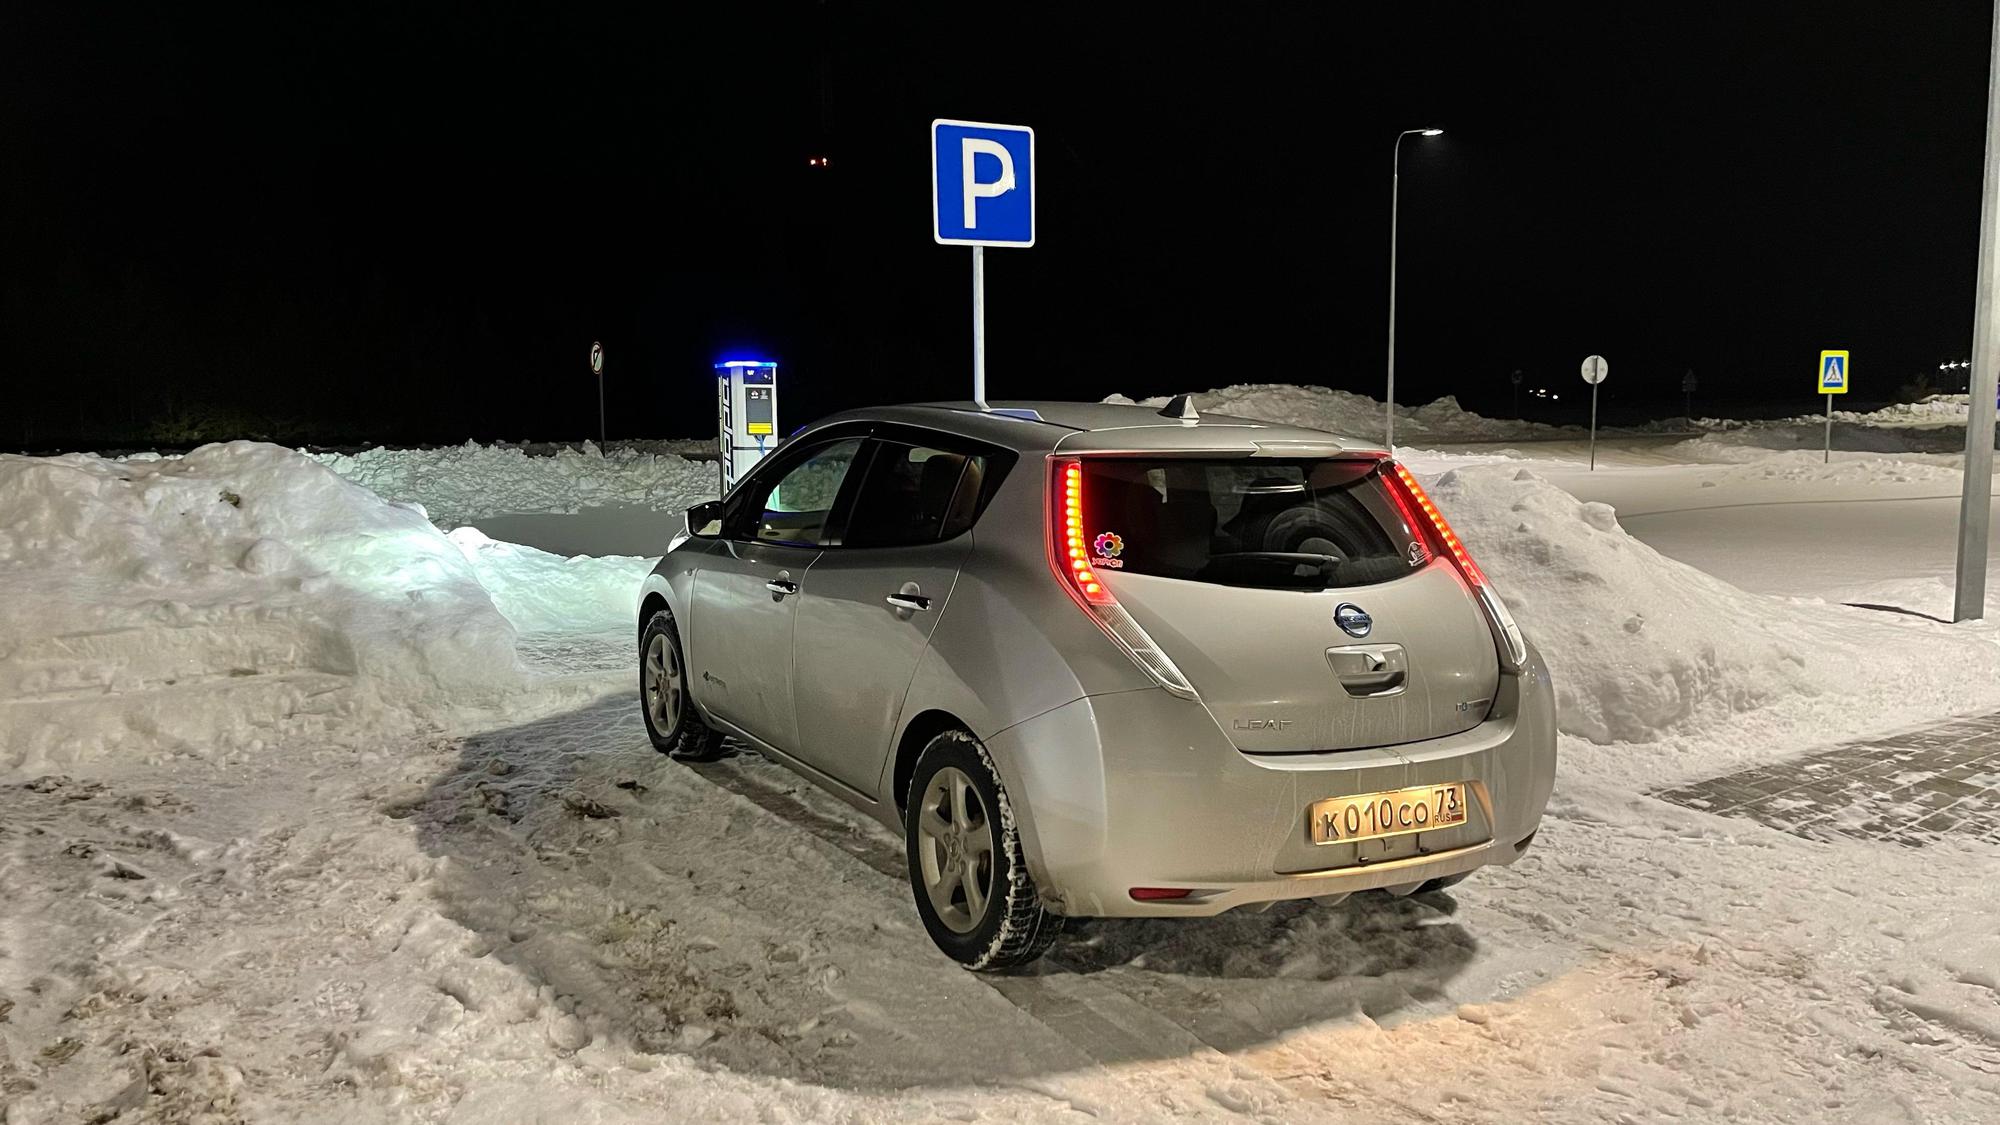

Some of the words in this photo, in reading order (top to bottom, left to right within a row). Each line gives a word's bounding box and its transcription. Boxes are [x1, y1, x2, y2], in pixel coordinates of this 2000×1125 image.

[962, 138, 1015, 229] P
[1233, 719, 1293, 731] LEAF
[1435, 788, 1457, 815] 73
[1435, 813, 1451, 823] RUS
